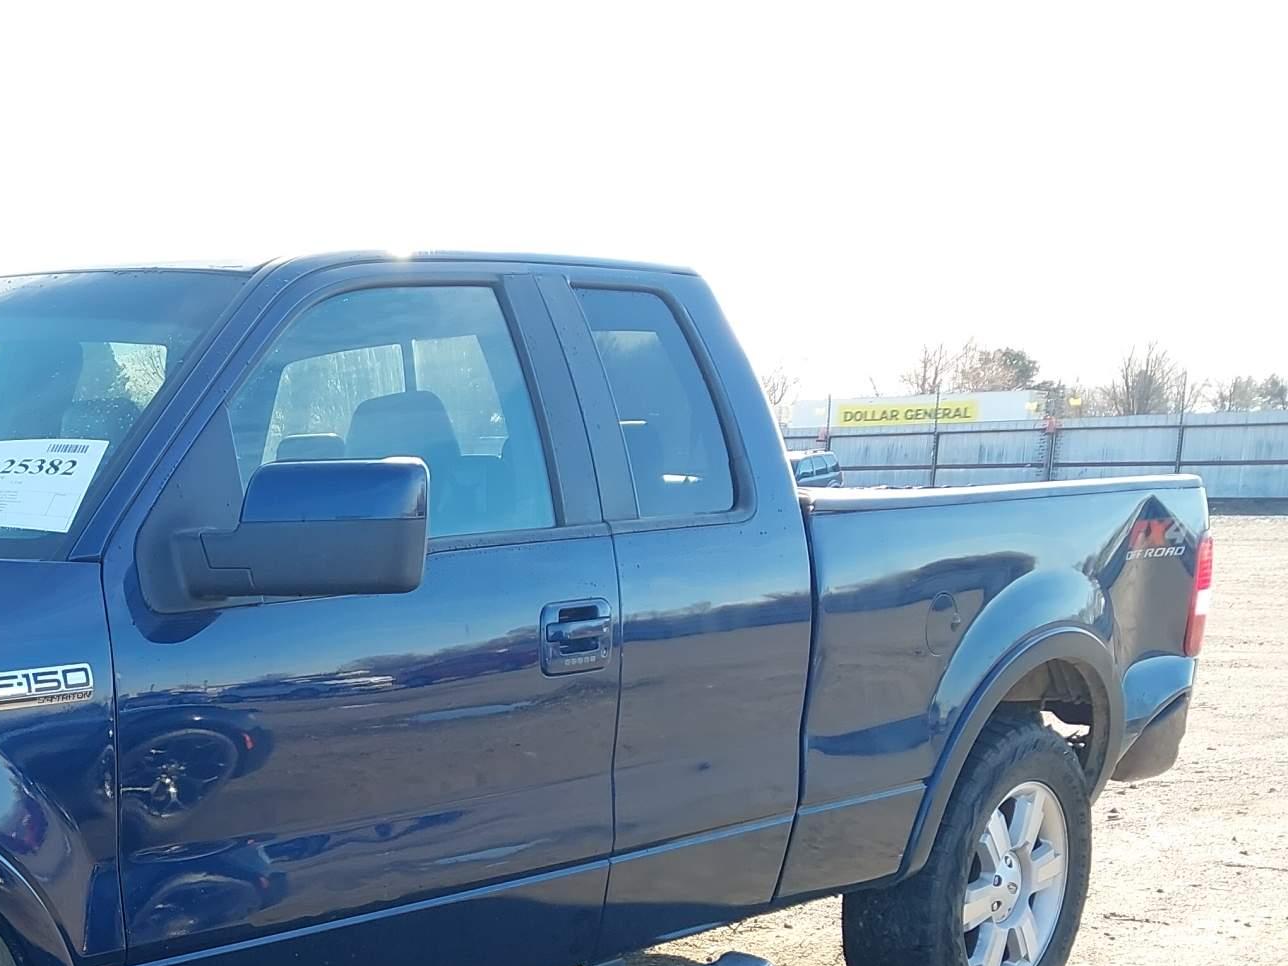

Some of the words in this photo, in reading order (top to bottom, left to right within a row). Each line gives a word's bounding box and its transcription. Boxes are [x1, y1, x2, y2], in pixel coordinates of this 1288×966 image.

[843, 409, 899, 422] DOLLAR
[903, 407, 972, 421] GENERAL
[1144, 546, 1186, 558] ROAD
